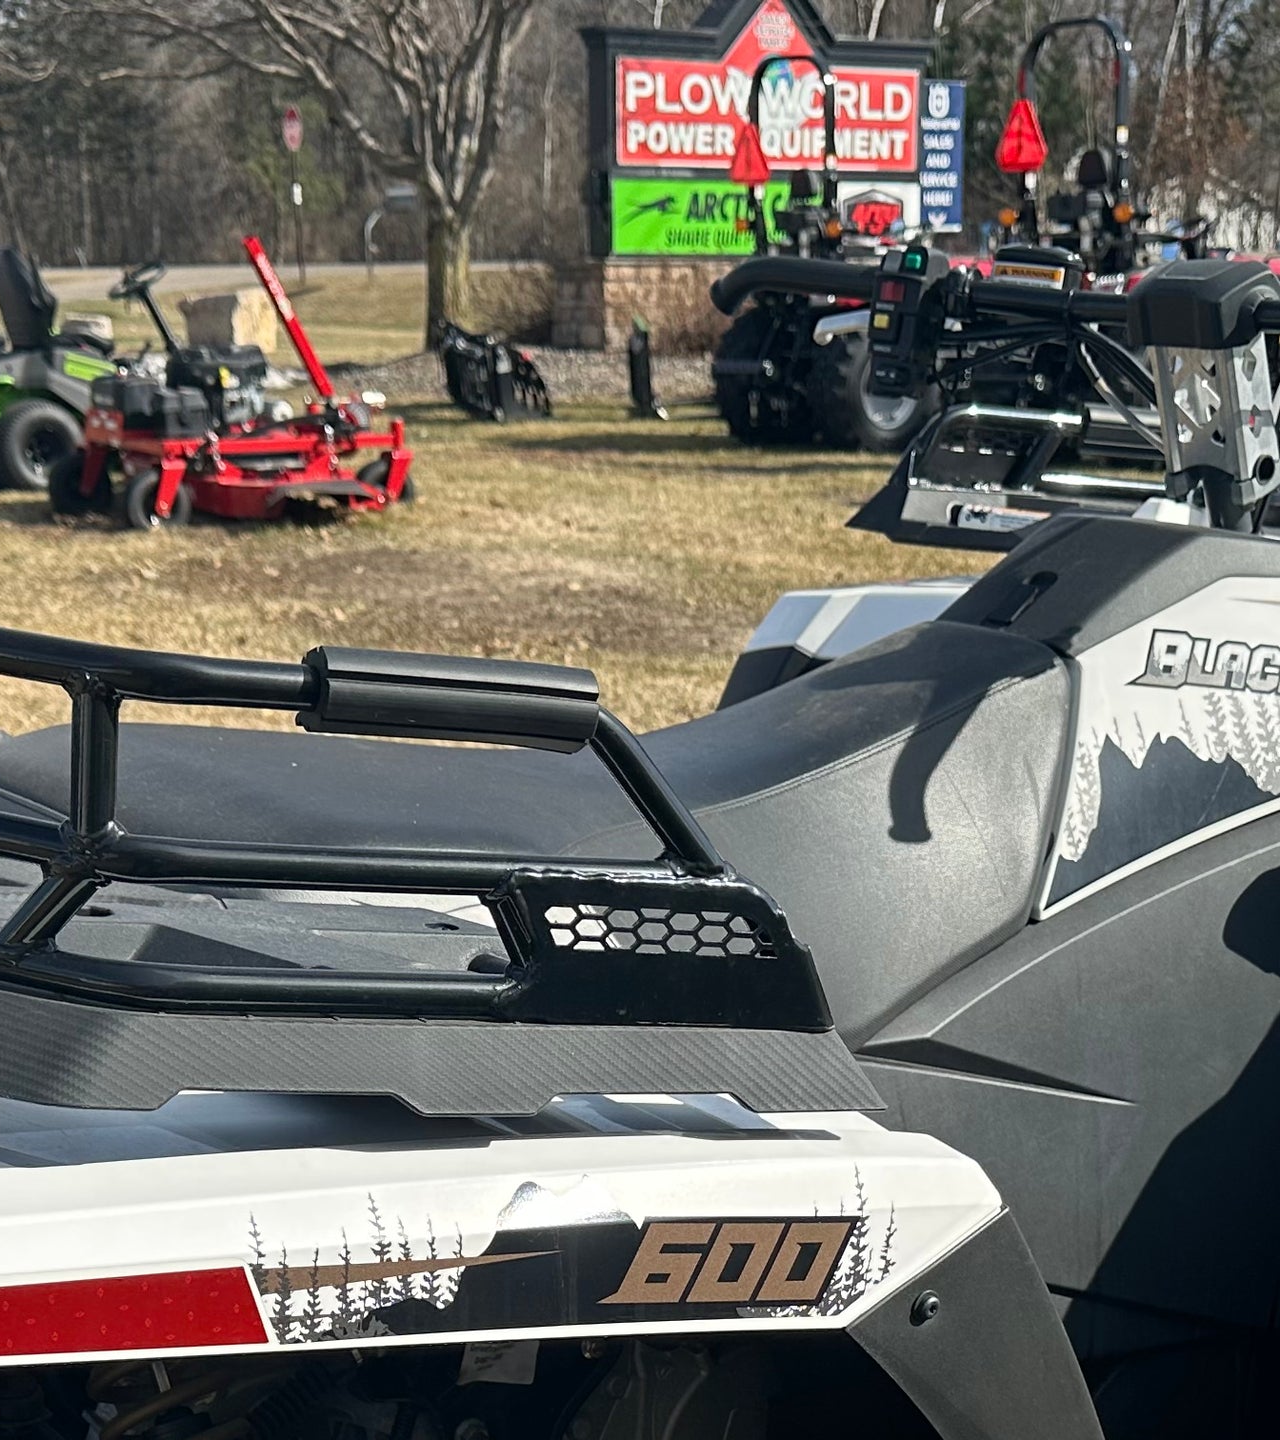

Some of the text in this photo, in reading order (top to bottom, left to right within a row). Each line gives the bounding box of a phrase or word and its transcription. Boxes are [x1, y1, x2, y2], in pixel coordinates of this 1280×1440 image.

[624, 70, 912, 122] PLOW WORLD
[626, 119, 909, 160] POWER QUIPMENT
[926, 152, 951, 169] AND
[686, 192, 753, 222] ARCT
[598, 1219, 856, 1304] 600
